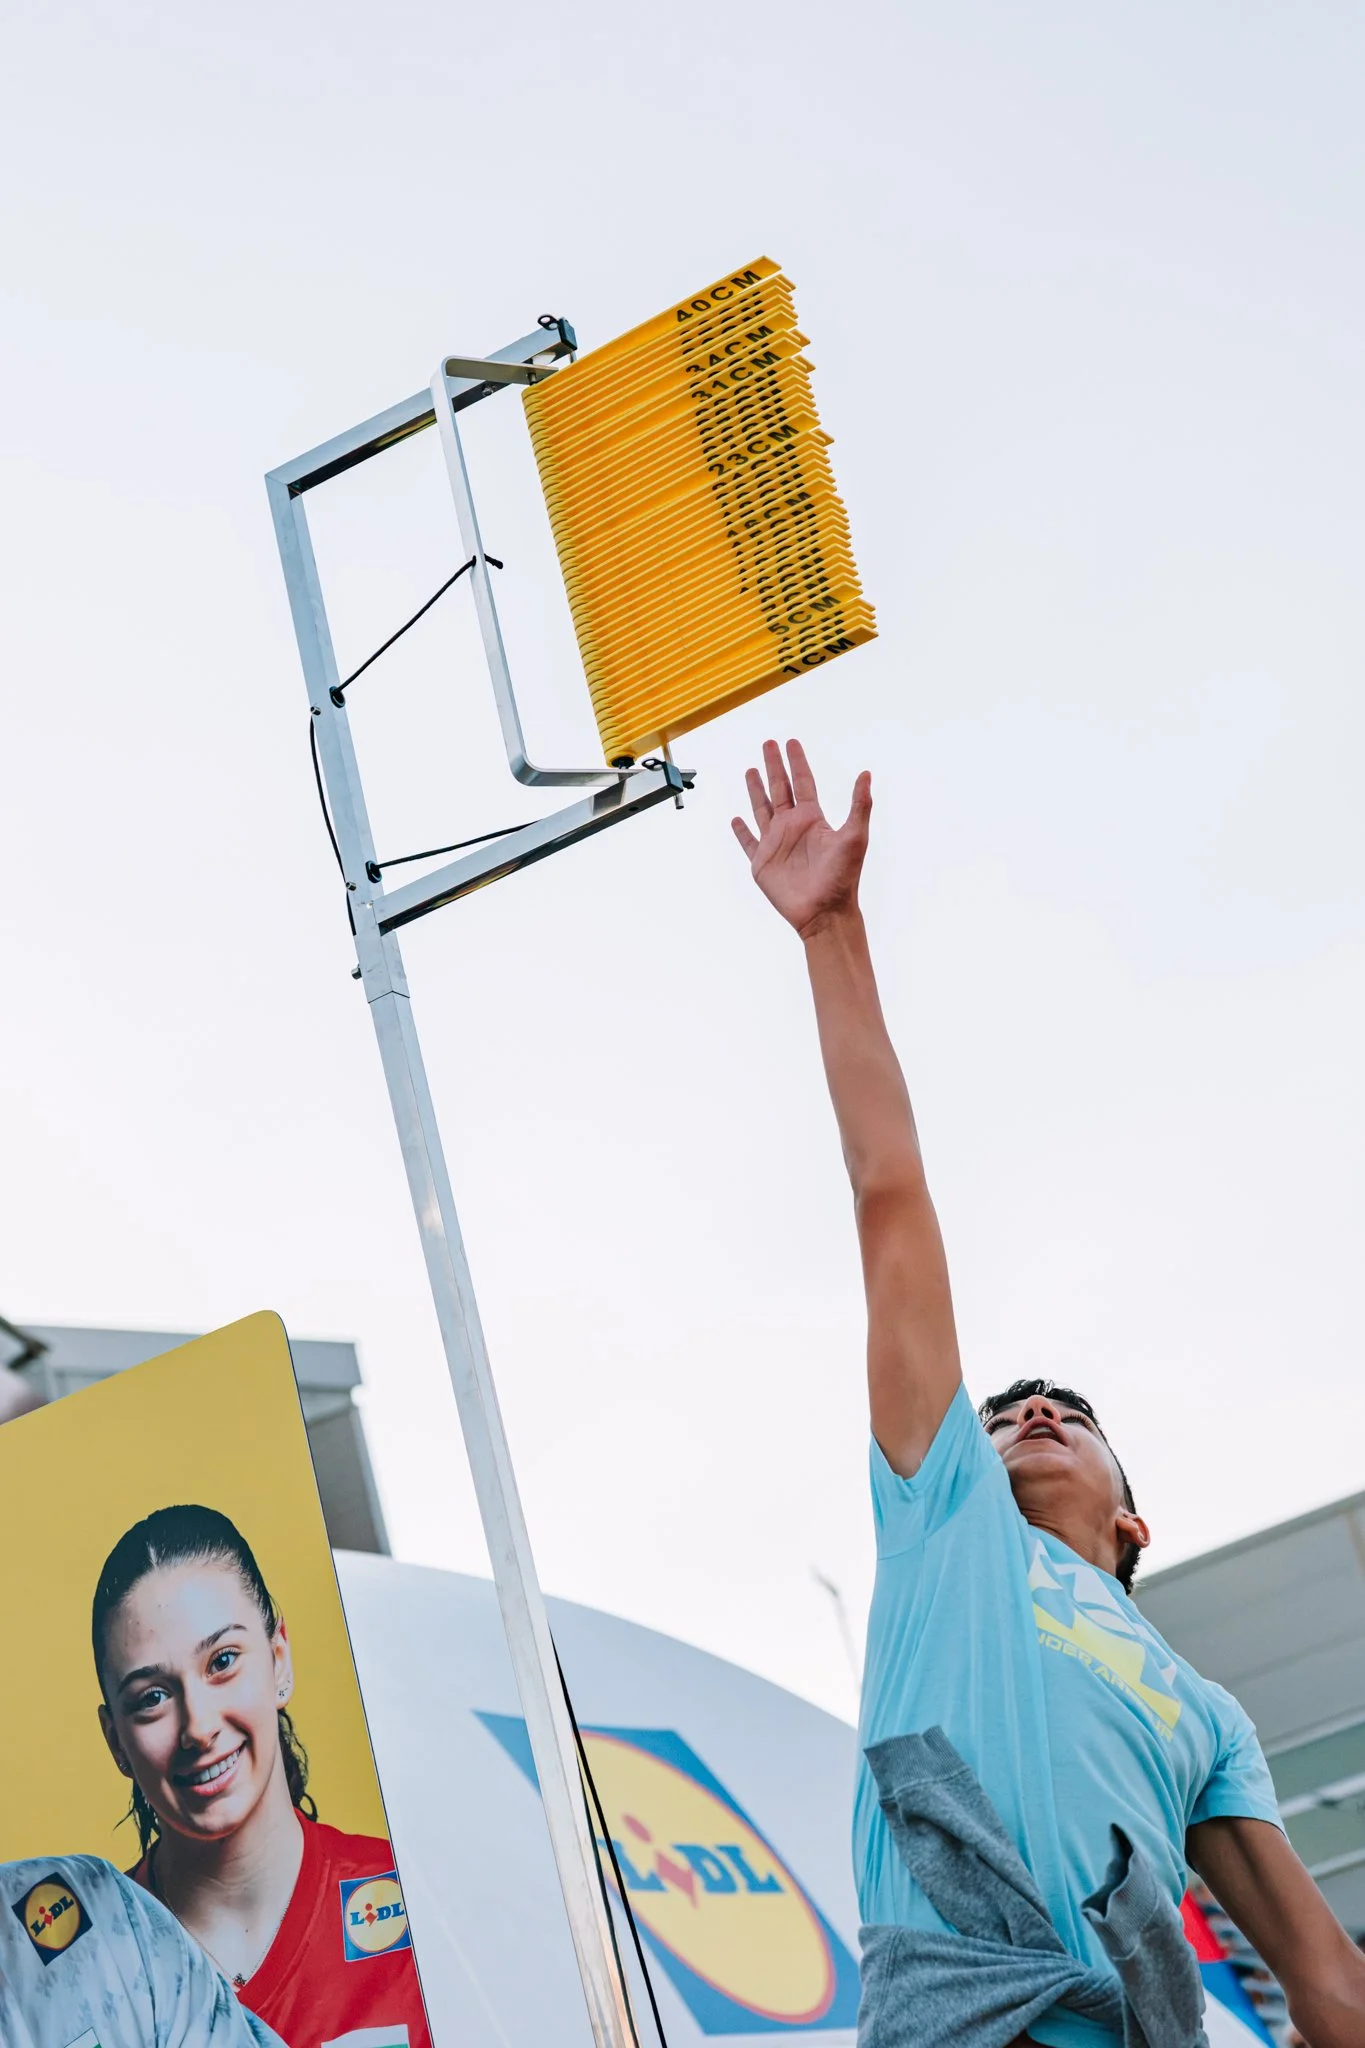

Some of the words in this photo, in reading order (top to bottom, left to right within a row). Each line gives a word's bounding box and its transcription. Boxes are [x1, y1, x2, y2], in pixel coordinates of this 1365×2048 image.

[676, 270, 762, 323] 40CM
[686, 325, 774, 376] 34CM
[691, 350, 782, 402] 31CM
[708, 423, 799, 477] 23CM
[768, 595, 841, 635] 5CM
[781, 636, 855, 676] 1CM
